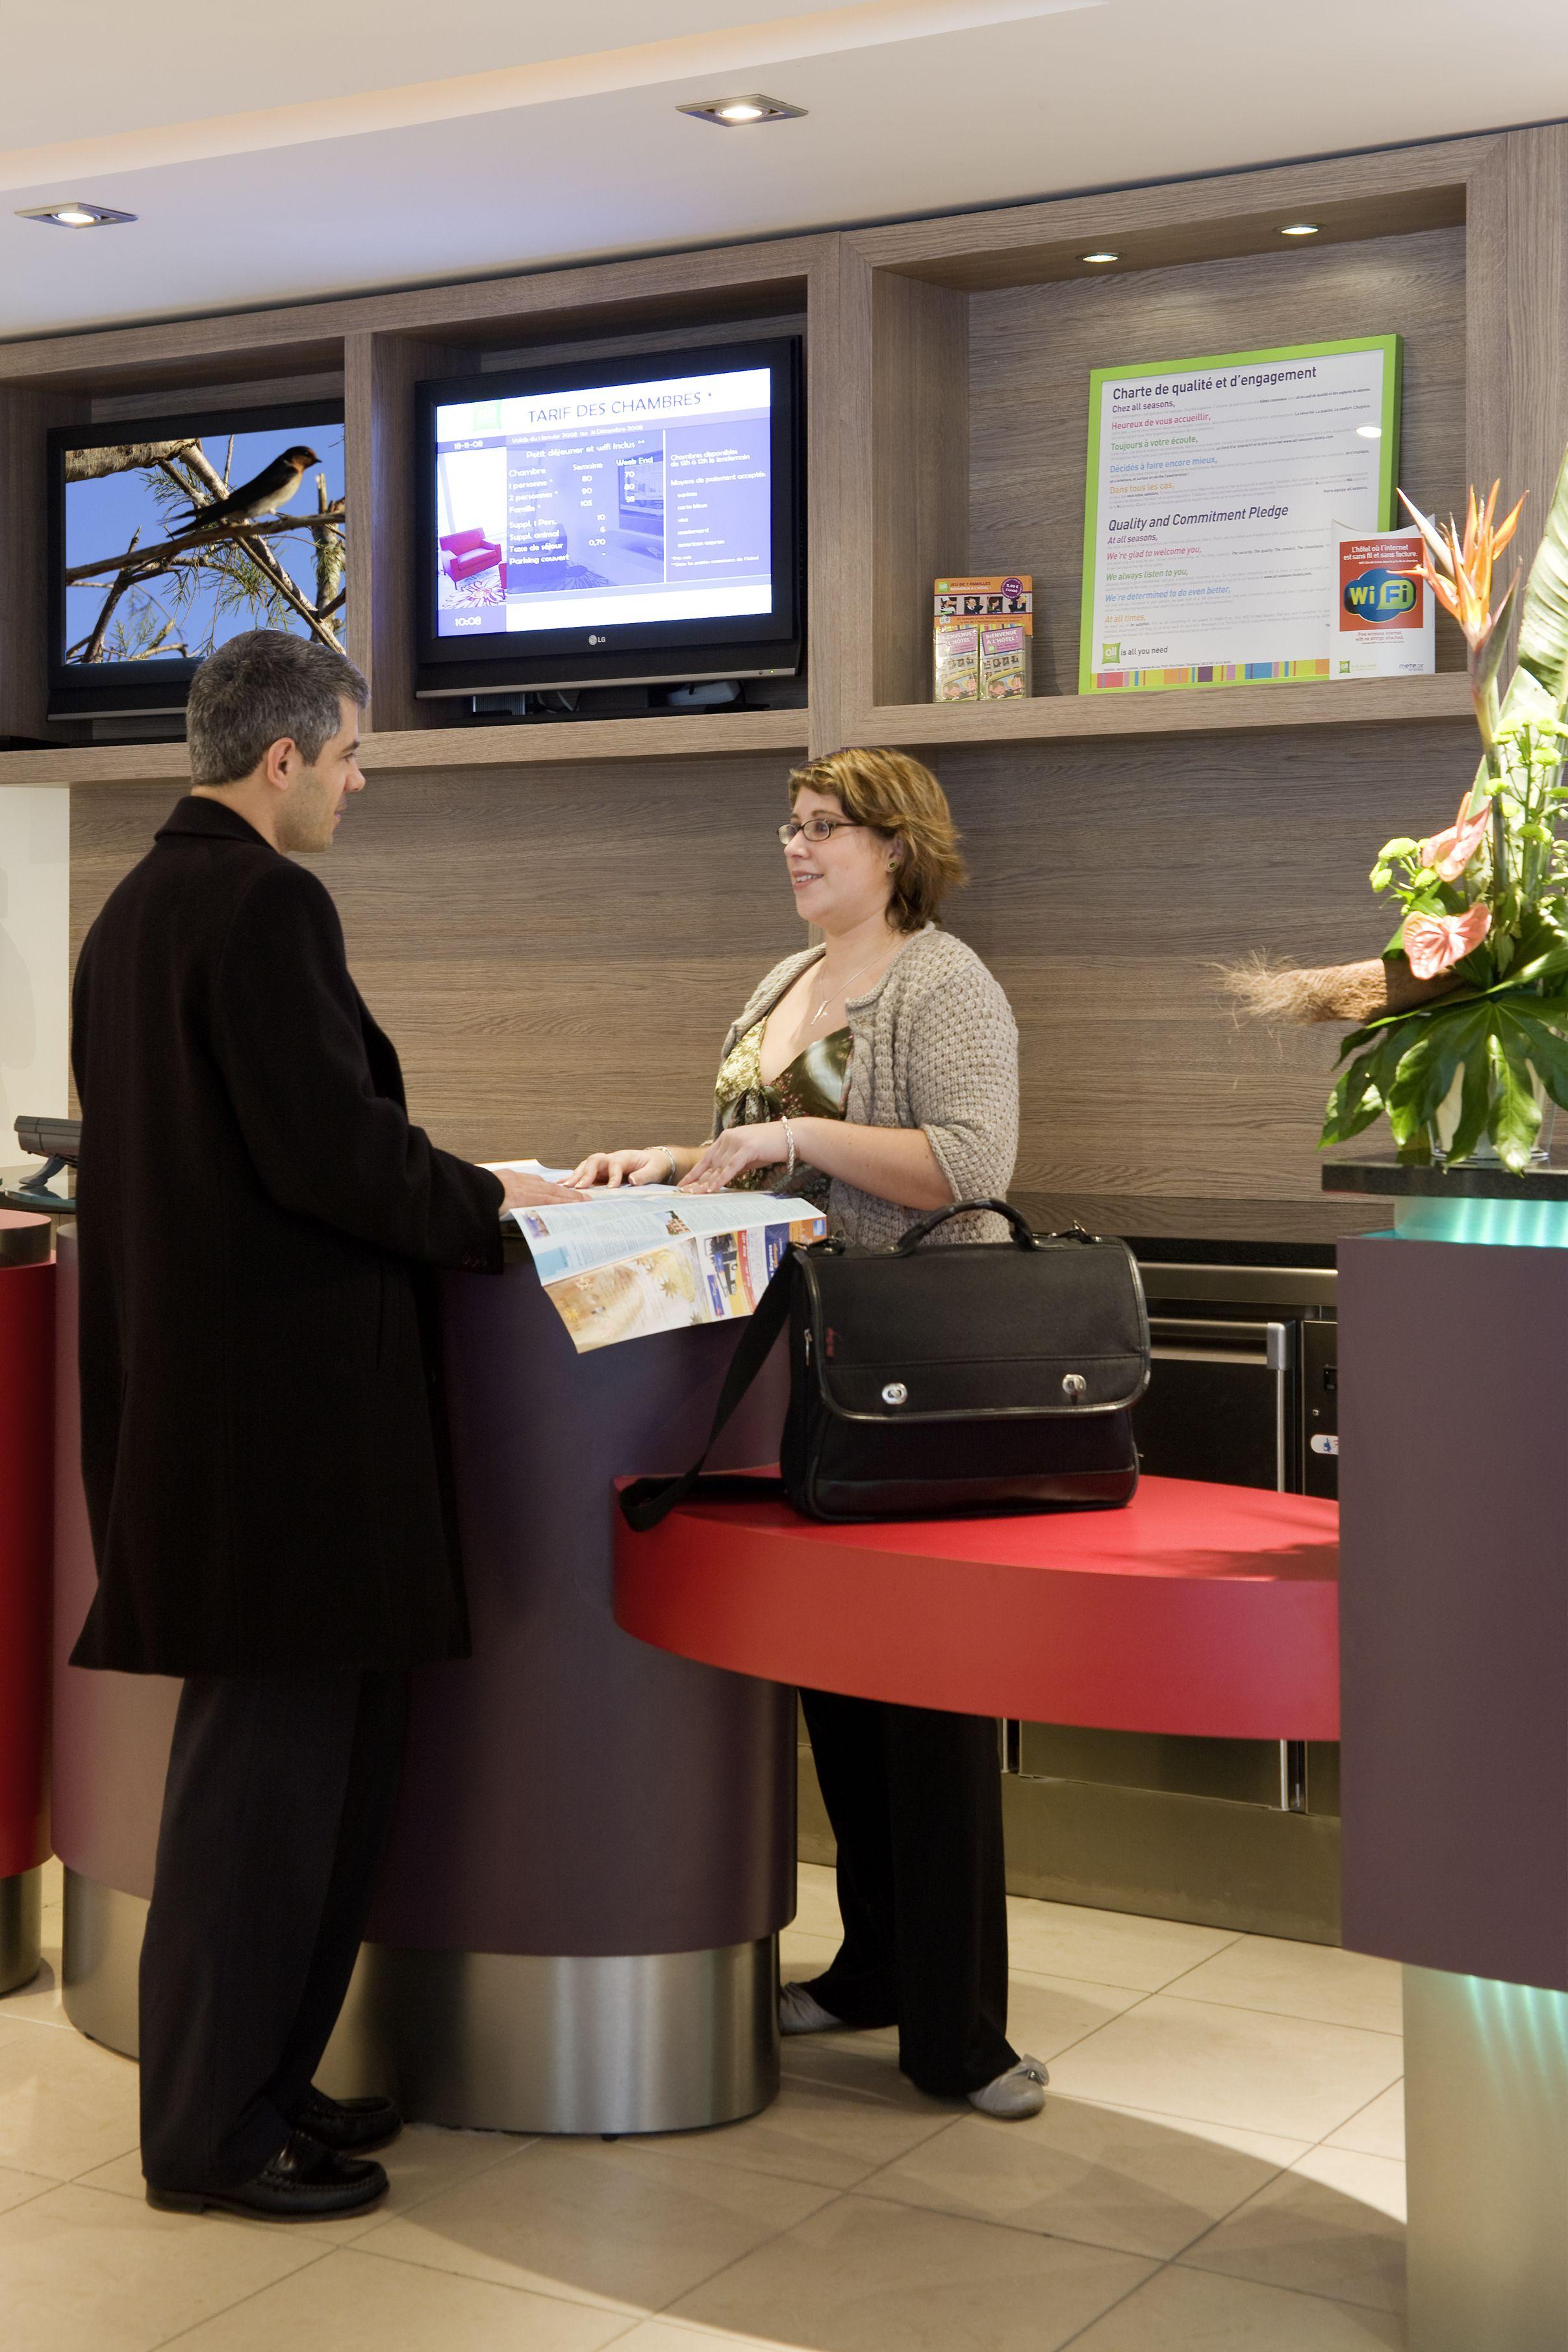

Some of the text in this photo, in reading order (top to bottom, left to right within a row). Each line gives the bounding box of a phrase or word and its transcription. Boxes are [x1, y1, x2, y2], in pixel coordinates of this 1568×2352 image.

[1113, 387, 1152, 400] Charte
[1155, 383, 1169, 395] de
[1172, 377, 1213, 396] qualité
[1215, 377, 1227, 389] et
[528, 392, 701, 422] TARIF DES CHAMBRES
[1112, 405, 1130, 413] Chez
[1132, 402, 1141, 411] all
[1143, 400, 1175, 410] seasons,
[1111, 421, 1143, 430] Heureux
[1144, 418, 1154, 426] de
[1174, 413, 1211, 424] accueillir,
[1111, 442, 1143, 452] Toujours
[1150, 439, 1169, 447] votre
[1171, 435, 1198, 445] écoute,
[526, 449, 546, 459] Petit
[548, 447, 583, 457] déjeuner
[670, 452, 702, 461] Chambres
[716, 454, 751, 463] lendemain
[509, 456, 653, 478] Chambre Semaine Week End
[1110, 464, 1139, 473] Décidés
[1165, 459, 1191, 468] encore
[1192, 456, 1217, 465] mieux,
[1109, 486, 1128, 494] Dans
[1130, 484, 1146, 492] tous
[1159, 481, 1174, 490] cas,
[1108, 505, 1289, 531] Quality and Commitment Pledge
[534, 530, 559, 539] animal
[1127, 534, 1158, 543] seasons,
[541, 542, 563, 551] séjour
[1128, 550, 1144, 560] glad
[1154, 548, 1185, 556] welcome
[1187, 546, 1202, 555] you,
[509, 554, 570, 565] Parking couvert
[1118, 571, 1143, 581] always
[1144, 569, 1164, 578] listen
[1174, 568, 1189, 578] you,
[1126, 590, 1169, 601] determined
[1169, 589, 1177, 597] to
[1178, 588, 1187, 596] do
[1206, 586, 1231, 594] better,
[454, 616, 482, 627] 10:08
[1104, 615, 1113, 624] At
[1124, 613, 1146, 622] times,
[1105, 646, 1117, 657] all
[1137, 648, 1150, 656] you
